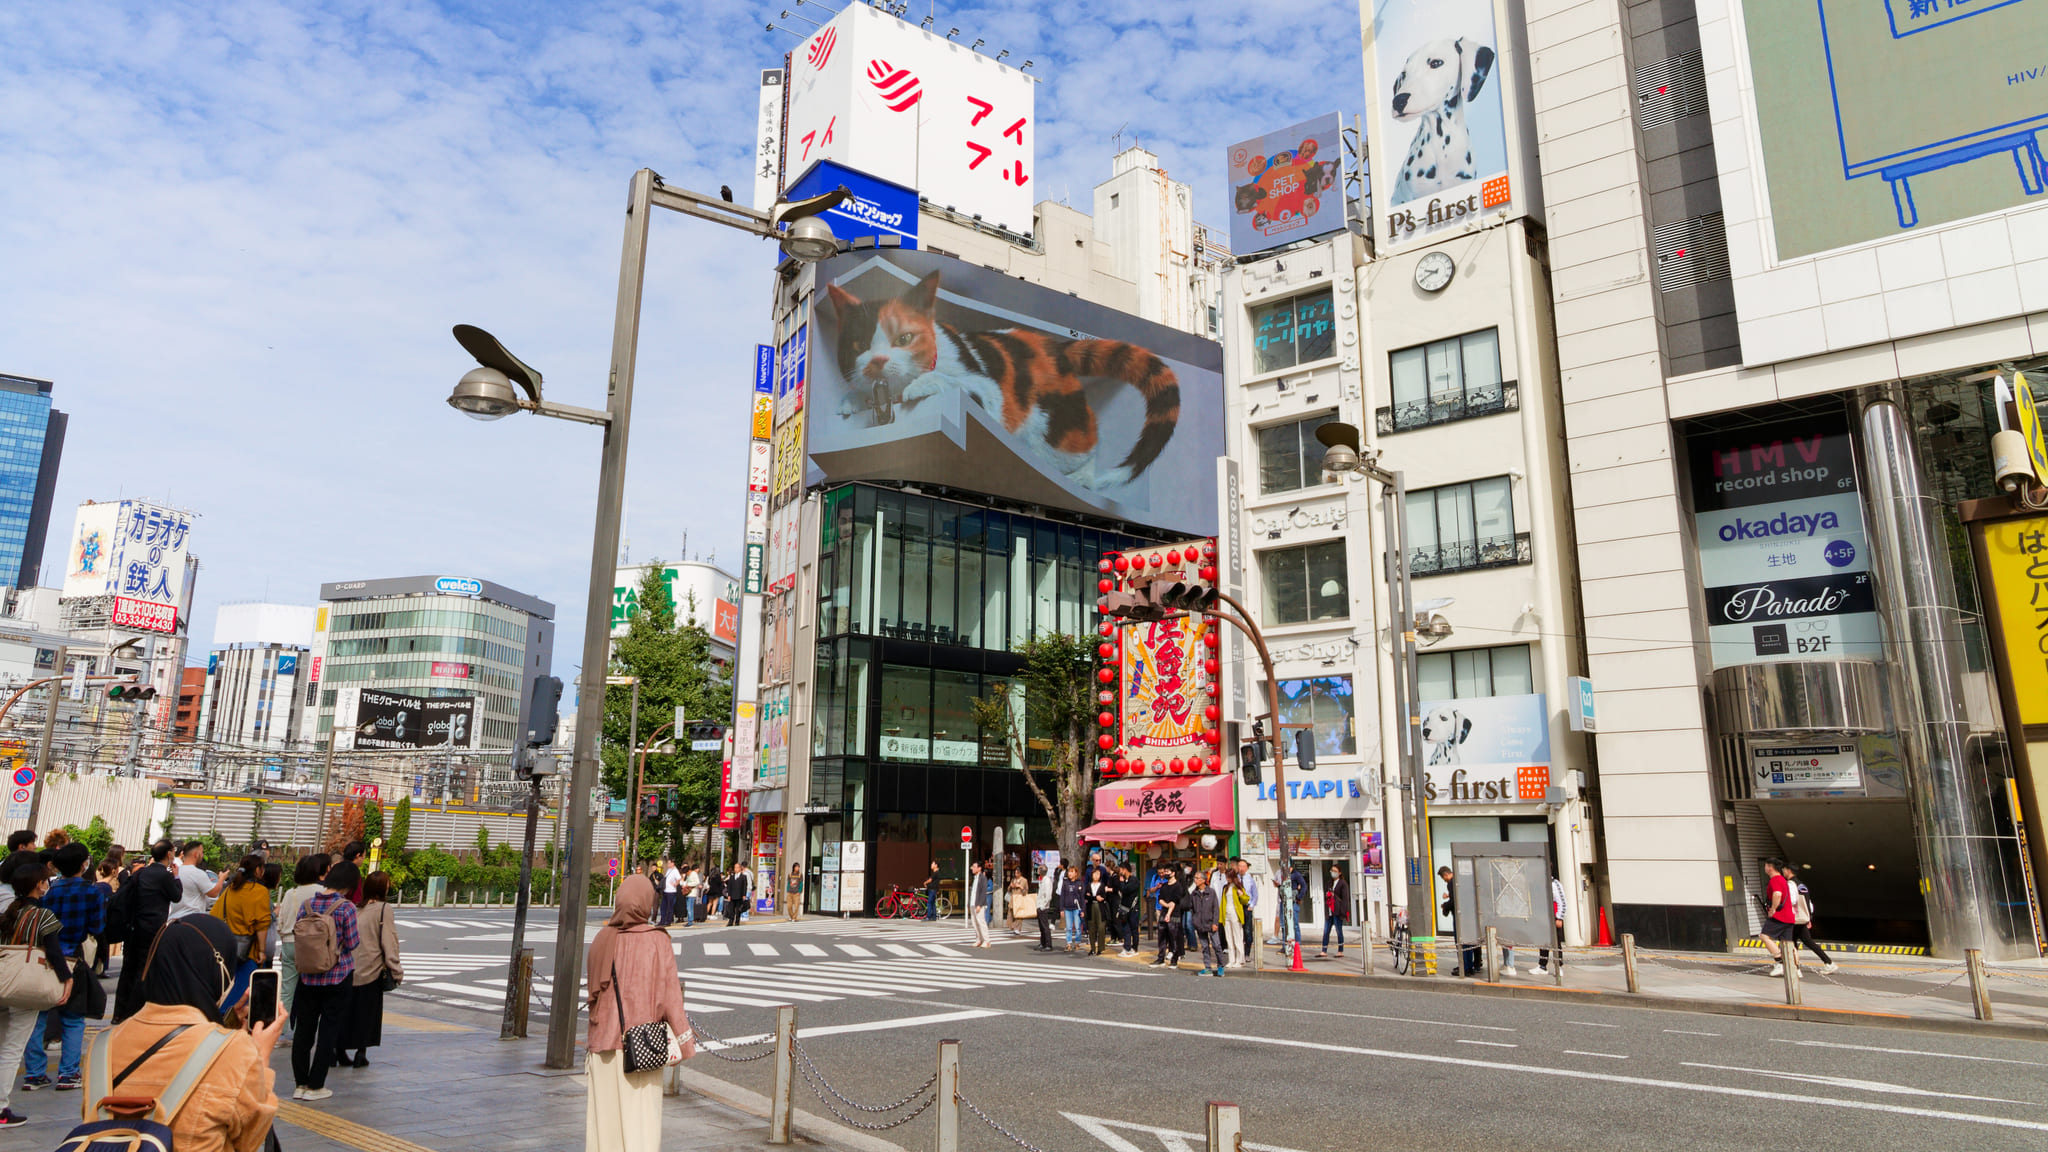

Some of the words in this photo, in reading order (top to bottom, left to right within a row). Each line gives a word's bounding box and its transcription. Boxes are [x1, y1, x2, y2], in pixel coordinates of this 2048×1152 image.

[1269, 183, 1300, 199] SHOP
[1273, 174, 1295, 188] PET
[1387, 194, 1478, 238] P's-first
[1712, 433, 1823, 477] HMV
[1715, 471, 1776, 493] record
[1781, 466, 1829, 484] shop
[1837, 477, 1852, 489] 6F
[128, 503, 191, 552] カラオケ
[1294, 505, 1347, 529] Cafe
[1719, 511, 1839, 541] okadaya
[148, 544, 163, 568] の
[1767, 552, 1797, 568] 生地
[747, 545, 761, 593] 宝石広場
[1855, 574, 1868, 584] 2F
[123, 560, 175, 603] 鉄人
[440, 578, 479, 592] welcia
[1724, 584, 1850, 622] Parade
[1299, 640, 1354, 663] Shop
[1796, 636, 1831, 653] B2F
[1145, 736, 1193, 747] SHINJUKU
[1286, 779, 1343, 799] TAPI
